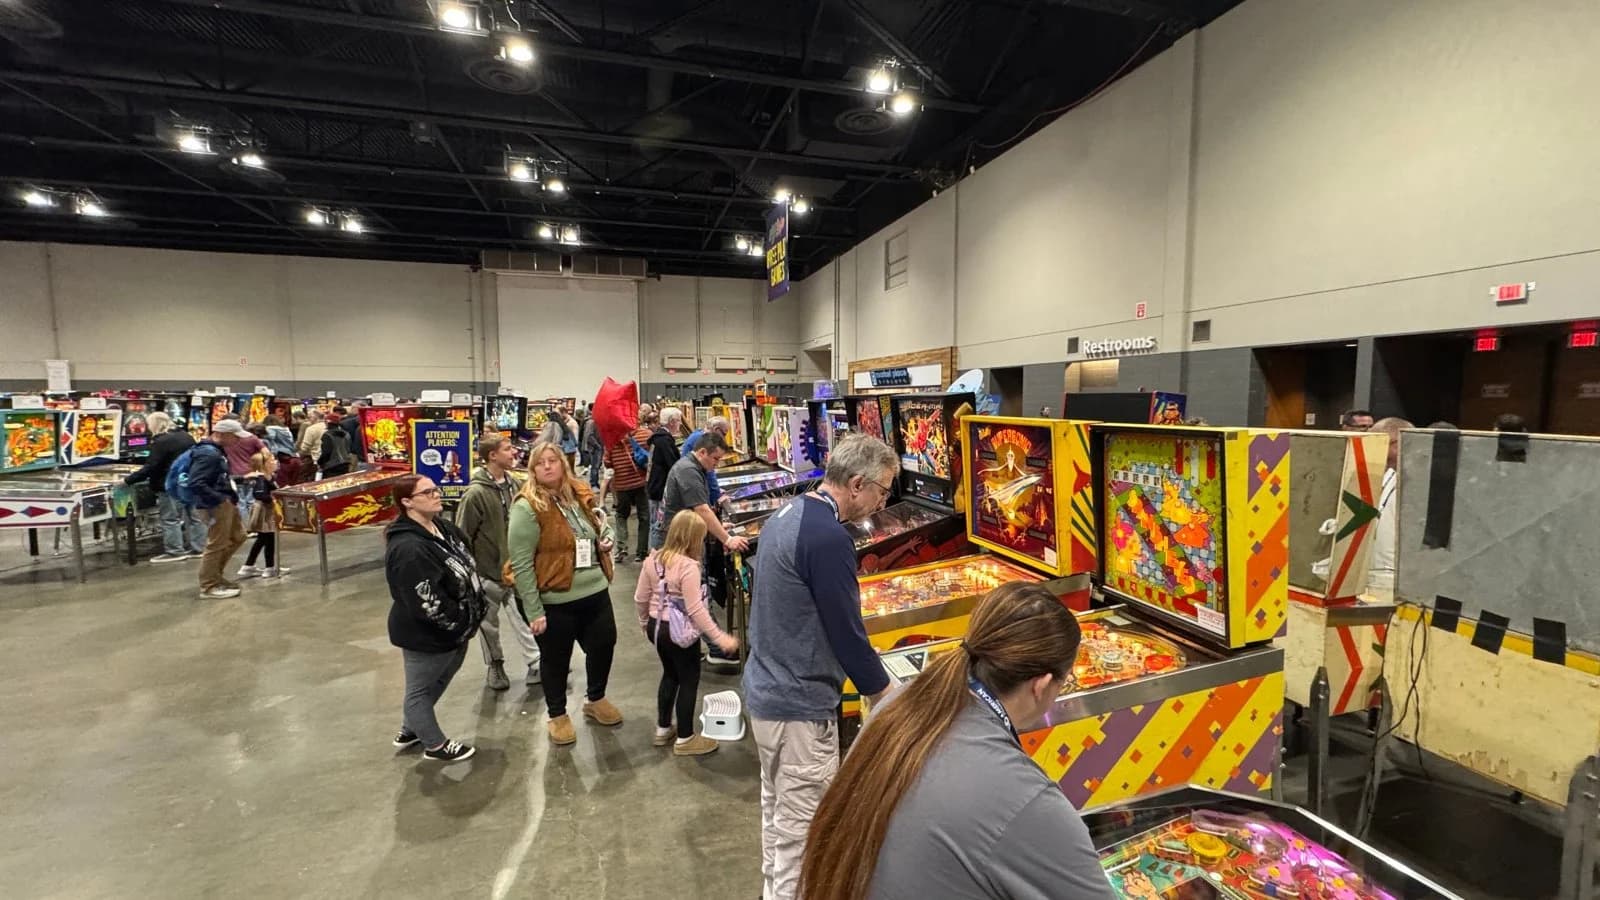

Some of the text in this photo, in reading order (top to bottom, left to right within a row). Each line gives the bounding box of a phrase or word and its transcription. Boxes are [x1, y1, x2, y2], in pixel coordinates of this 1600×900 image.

[1083, 336, 1155, 354] Restrooms
[1477, 338, 1497, 351] EXIT
[1571, 332, 1597, 347] EXIT
[425, 431, 460, 439] ATTENTION
[427, 439, 458, 447] PLAYERS:
[977, 688, 1004, 718] AMERICAN
